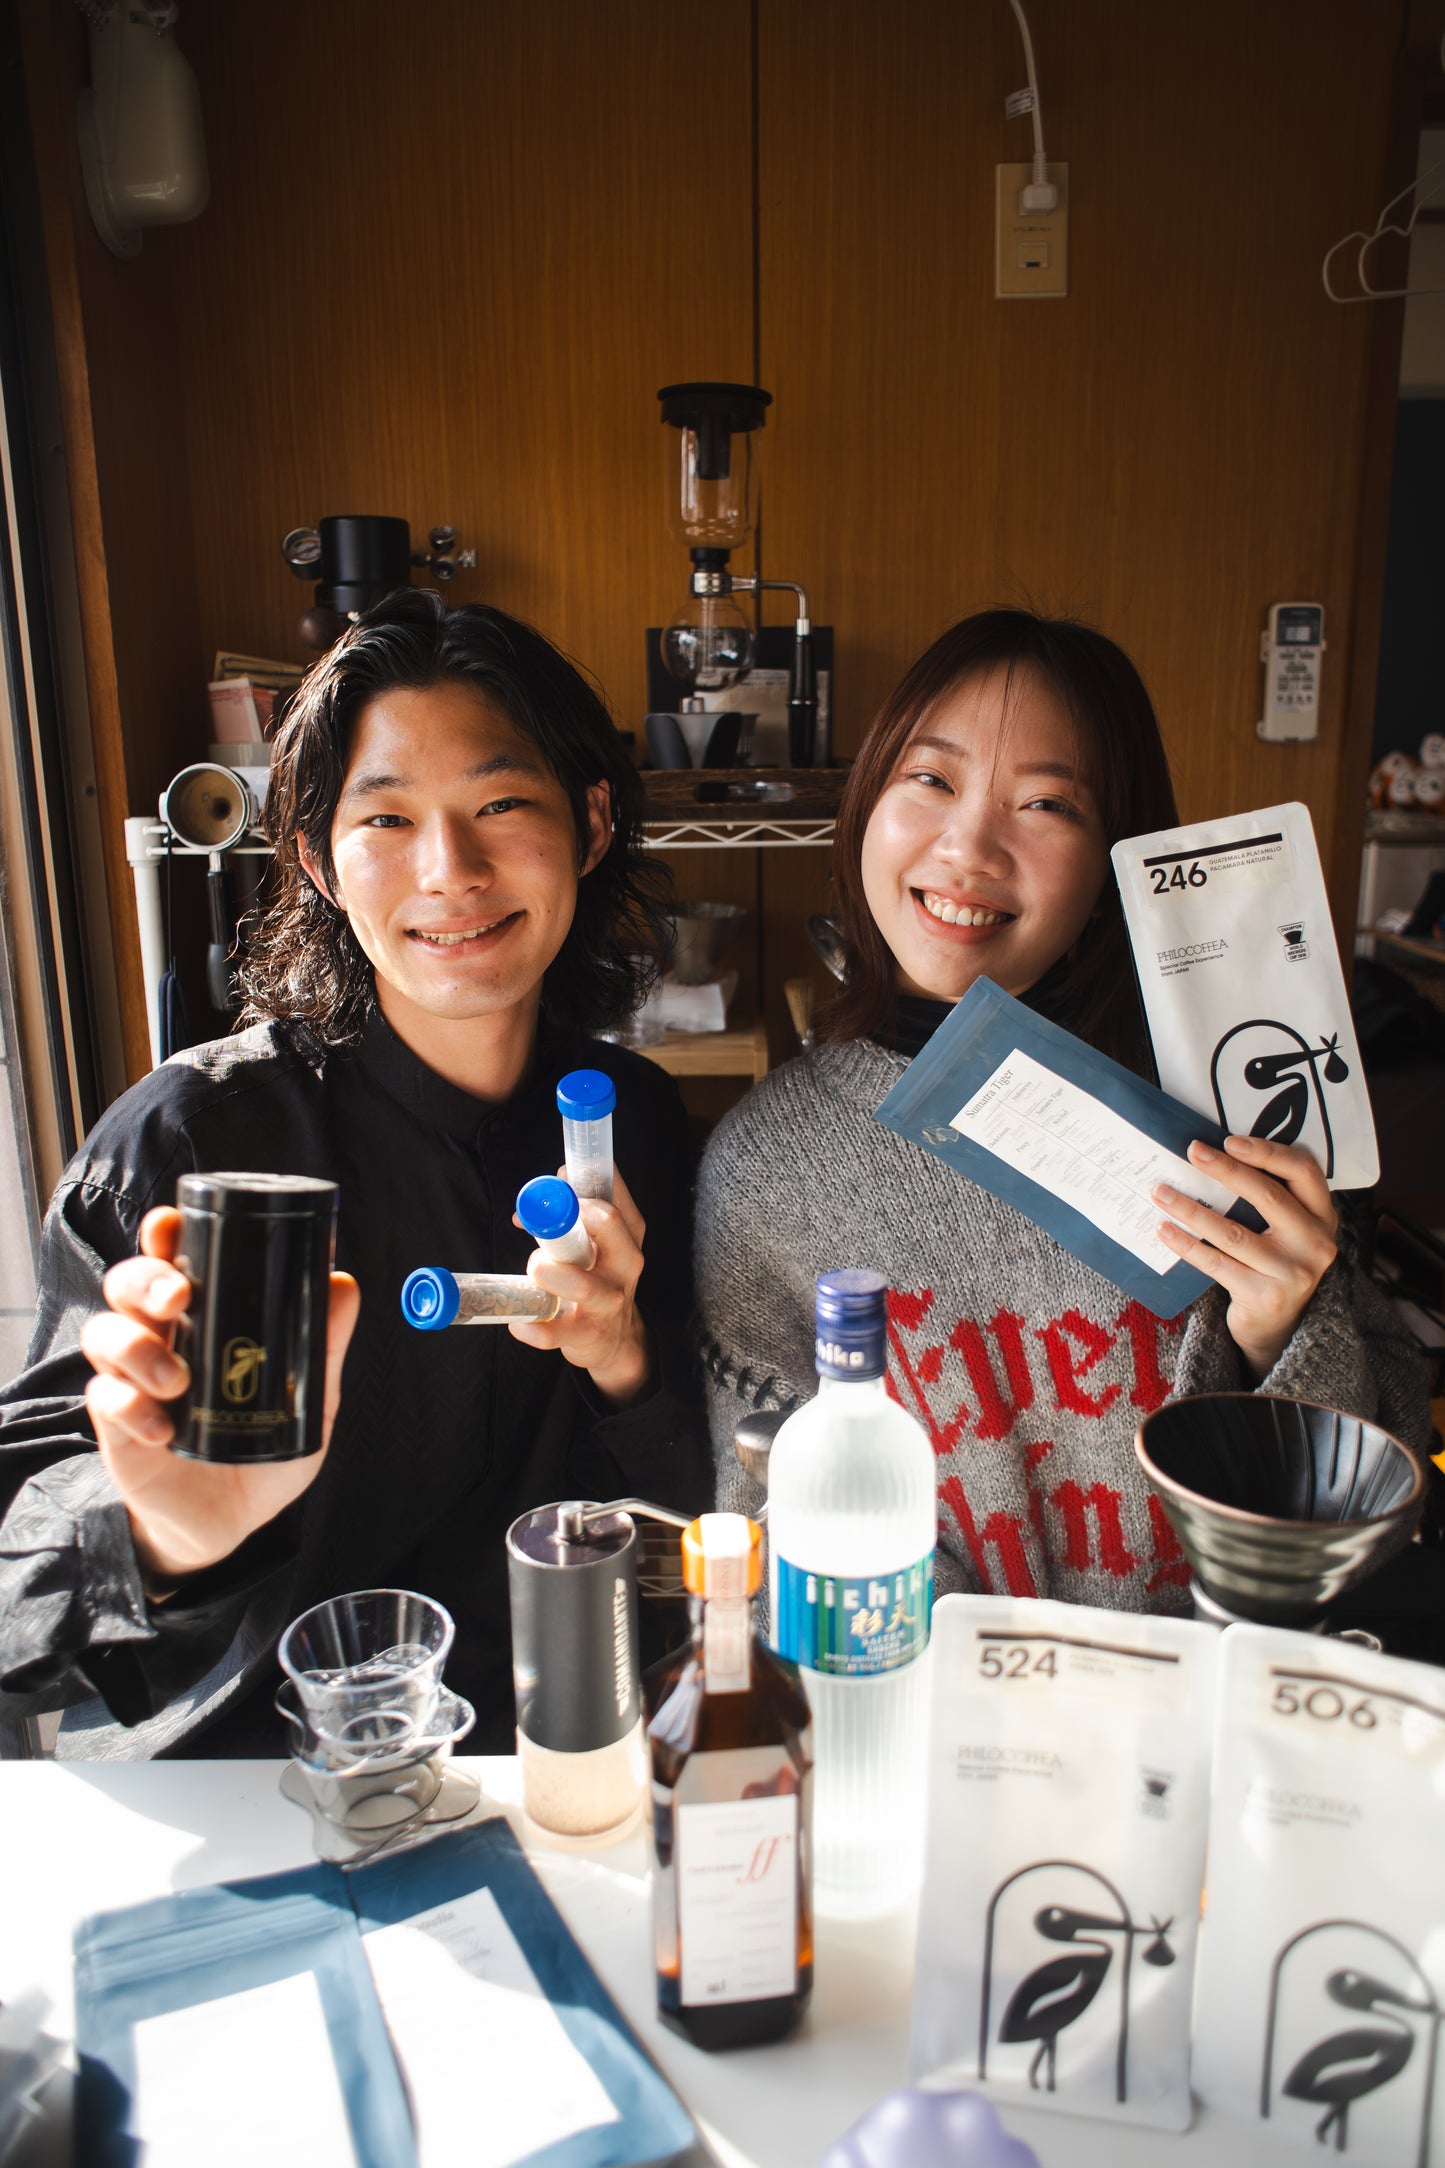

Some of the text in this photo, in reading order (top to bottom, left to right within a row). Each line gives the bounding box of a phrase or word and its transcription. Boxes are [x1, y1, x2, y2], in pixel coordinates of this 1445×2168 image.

[1209, 845, 1282, 866] GUATEMALA PLATANILLO
[1210, 854, 1274, 872] PACAMARA NATURAL
[1150, 861, 1207, 895] 246
[1157, 939, 1228, 962] PHILOCOFFEA
[1174, 967, 1189, 975] JAPAN
[965, 1087, 997, 1120] Sumatra
[991, 1067, 1014, 1091] Tiger
[613, 1592, 631, 1701] COMANDANTE
[979, 1645, 1058, 1679] 524
[1272, 1682, 1377, 1730] 506
